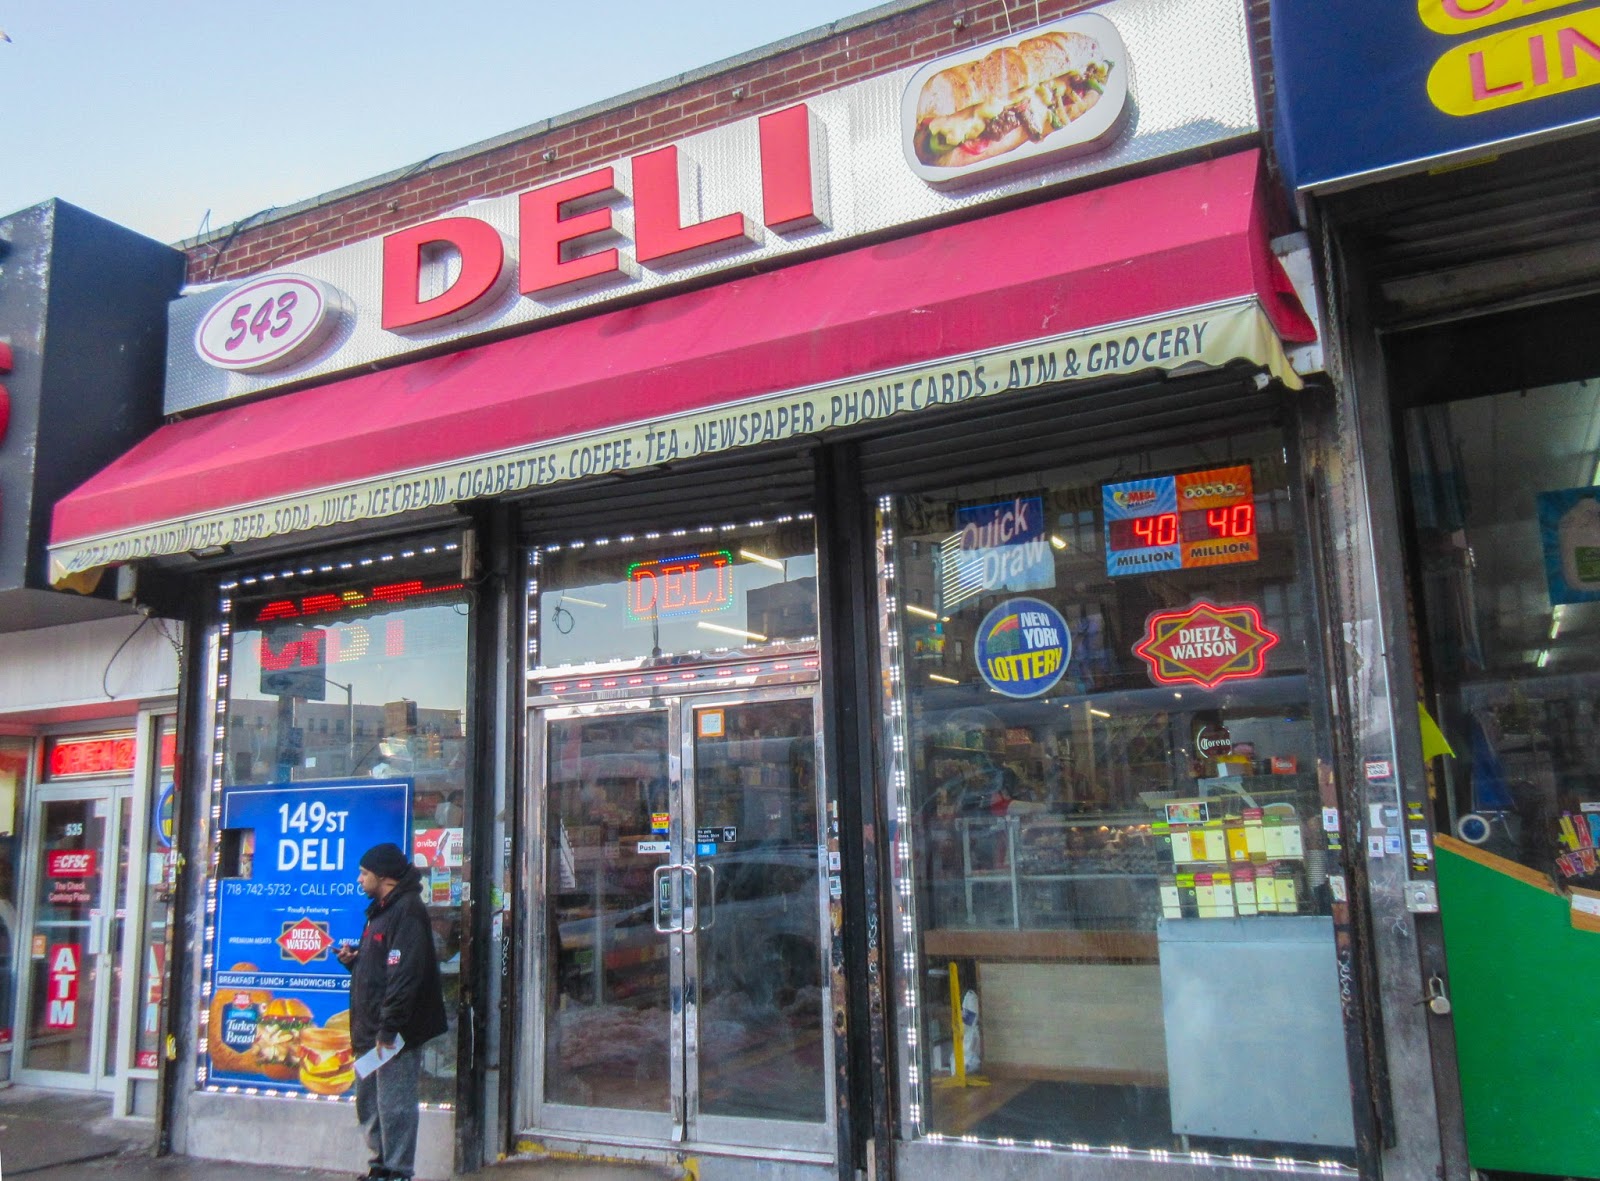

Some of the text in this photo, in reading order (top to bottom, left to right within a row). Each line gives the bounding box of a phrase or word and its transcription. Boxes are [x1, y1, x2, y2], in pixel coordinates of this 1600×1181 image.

[382, 103, 818, 330] DELI
[225, 291, 298, 351] 543
[67, 547, 100, 569] HOT
[144, 521, 223, 556] SANDWICHES
[232, 513, 265, 538] BEER
[274, 504, 310, 532] SODA
[318, 493, 357, 525] JUICE
[457, 454, 556, 499] CIGARETTES
[569, 438, 632, 478] COFFEE
[645, 428, 679, 463] TEA
[693, 401, 815, 454] NEWSPAPER
[831, 382, 904, 426] PHONE
[910, 365, 987, 409] CARDS
[1008, 351, 1057, 388] ATM
[1063, 348, 1081, 377] &
[1087, 321, 1208, 372] GROCERY
[959, 498, 1028, 560] Quick
[1134, 513, 1177, 546] 40
[1208, 504, 1252, 537] 40
[982, 533, 1045, 589] Draw
[1117, 552, 1174, 566] MILLION
[1191, 542, 1250, 557] MILLION
[633, 559, 728, 612] DELI
[1021, 612, 1050, 628] NEW
[1023, 626, 1059, 649] YORK
[1170, 640, 1237, 660] WATSON
[987, 648, 1063, 682] LOTTERY
[278, 801, 348, 834] 149ST
[65, 823, 83, 836] 535
[277, 838, 345, 871] DELI
[639, 843, 656, 851] Push
[57, 854, 90, 868] CFSC
[226, 883, 291, 896] 718-742-5732
[300, 883, 327, 896] CALL
[330, 882, 354, 896] FOR
[286, 939, 321, 950] WATSON
[50, 947, 77, 1025] ATM
[218, 975, 255, 985] BREAKFAST
[260, 976, 284, 986] LUNCH
[289, 978, 336, 987] SANDWICHES
[225, 1018, 257, 1035] Turkey
[226, 1030, 256, 1044] Breast
